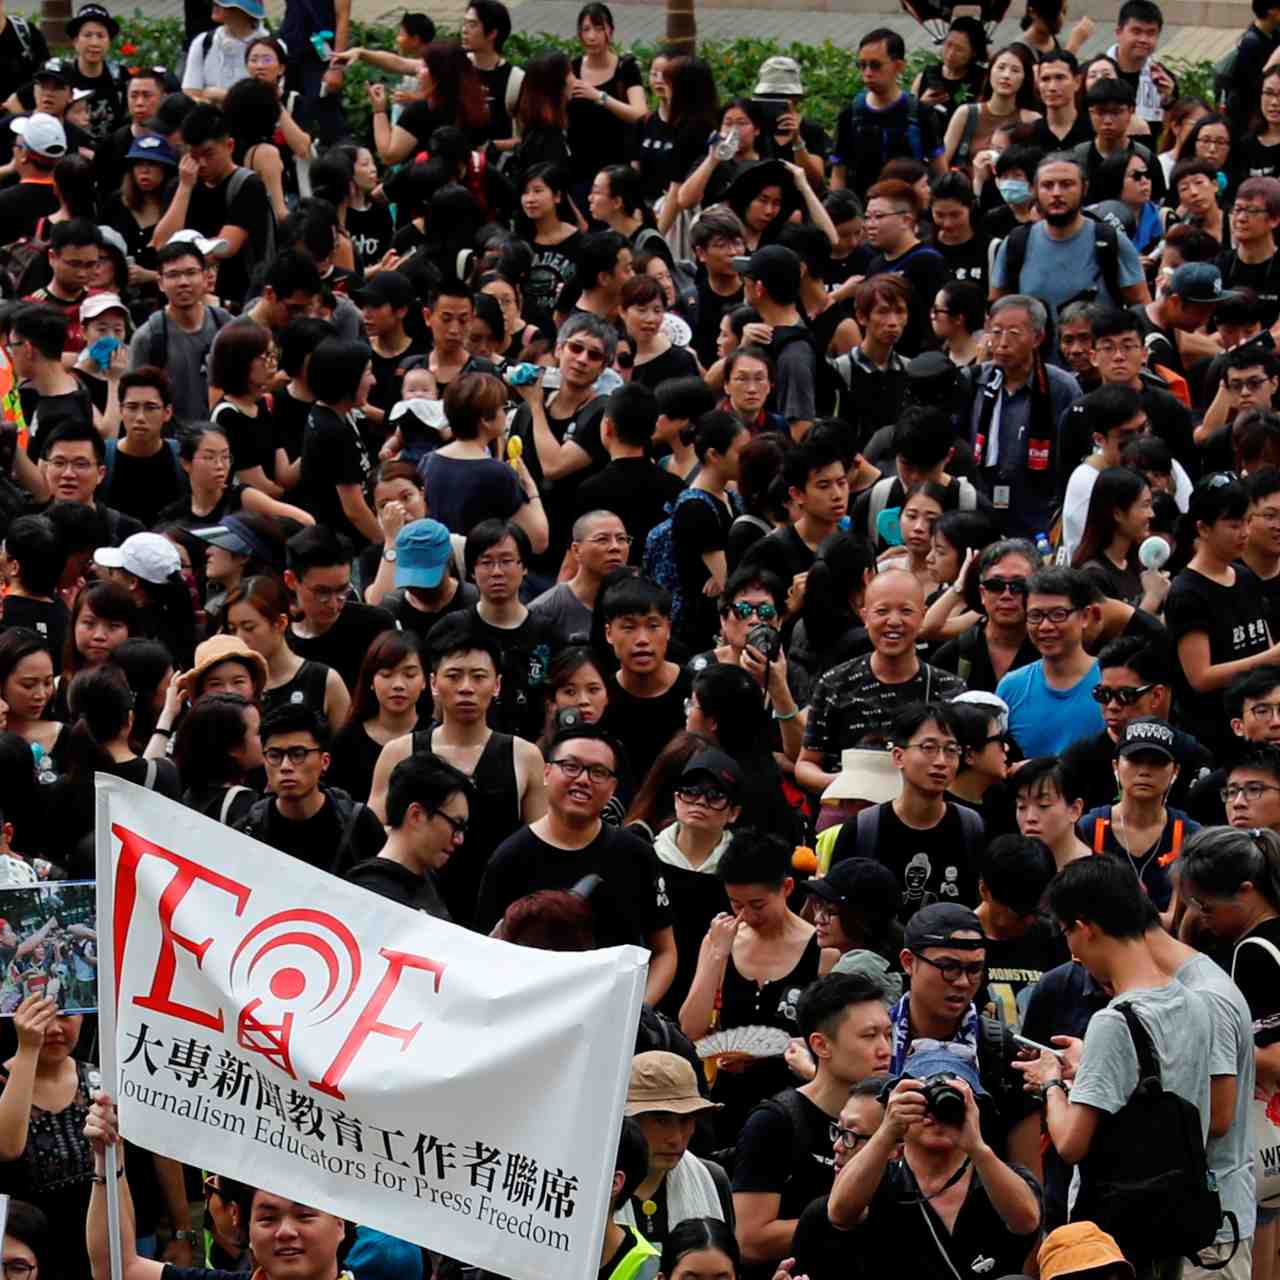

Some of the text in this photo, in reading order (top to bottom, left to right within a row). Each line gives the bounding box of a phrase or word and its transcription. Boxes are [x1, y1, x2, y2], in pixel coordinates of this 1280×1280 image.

[119, 1066, 571, 1252] Journalism Educators for Press Freedom
